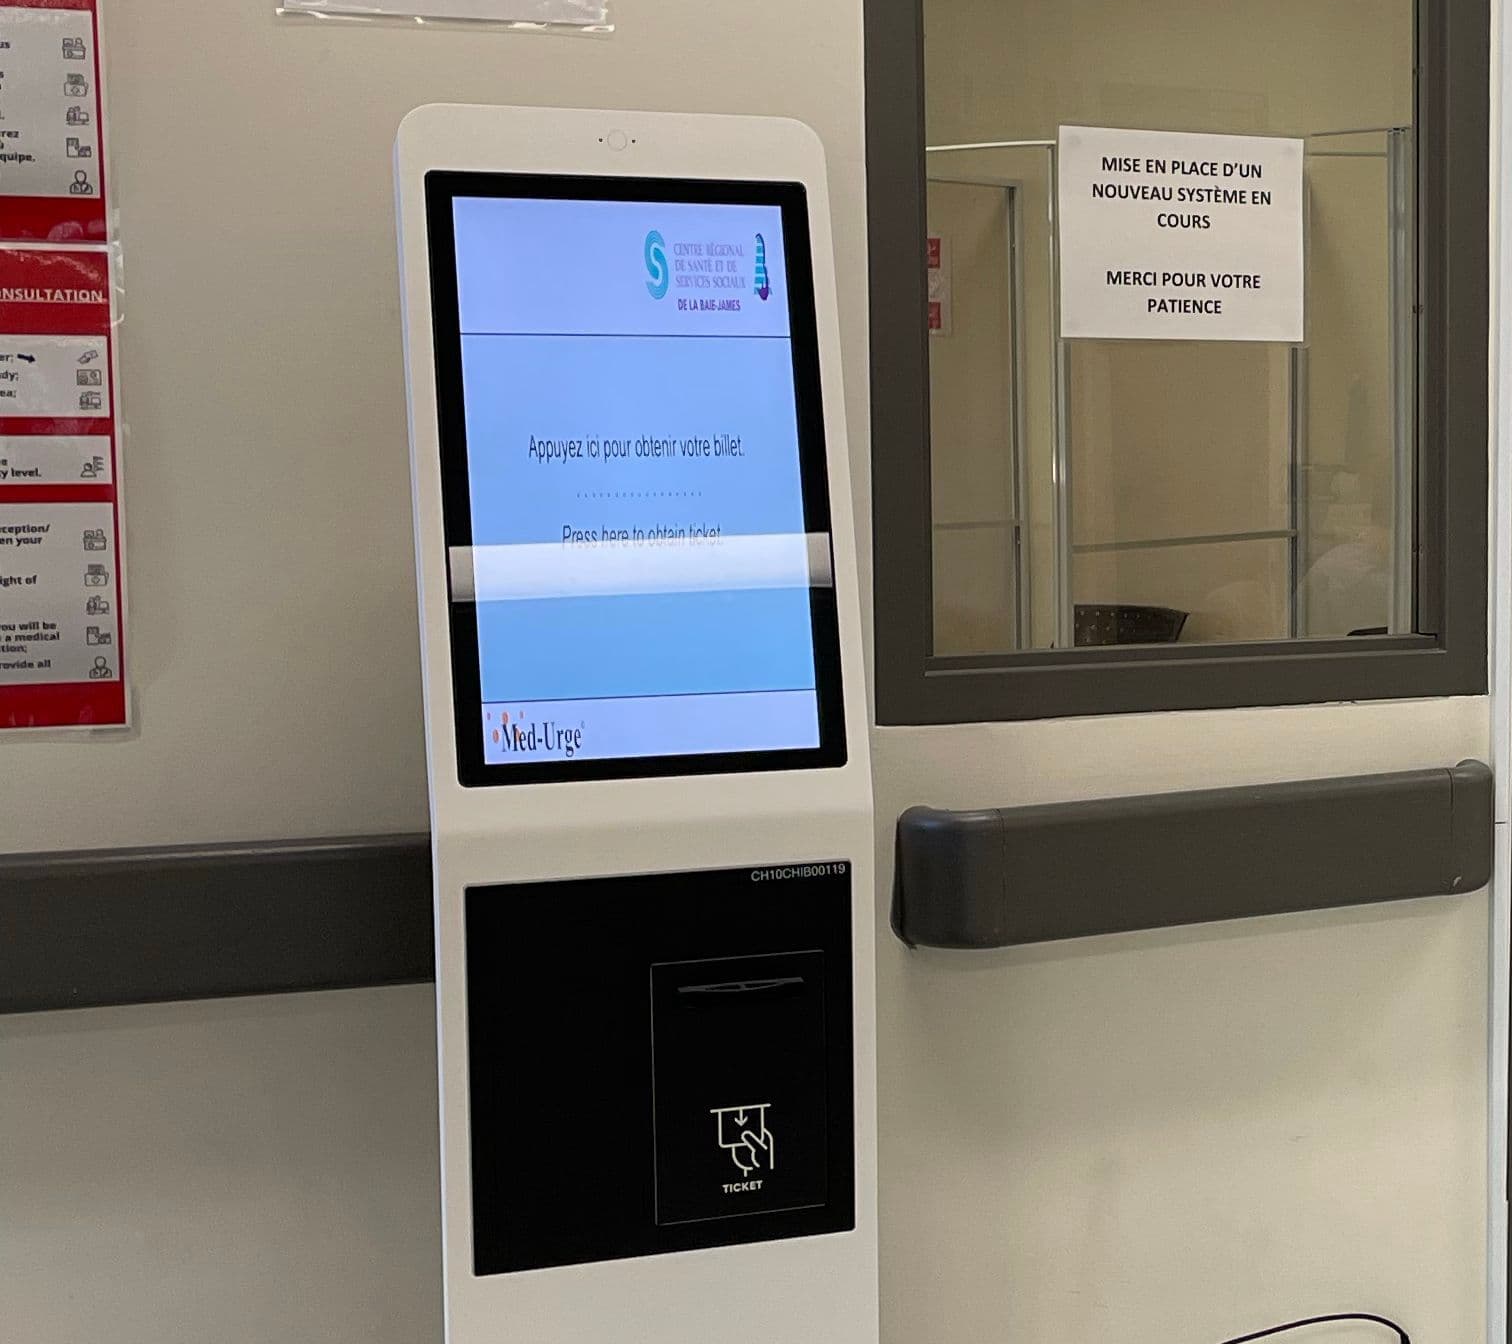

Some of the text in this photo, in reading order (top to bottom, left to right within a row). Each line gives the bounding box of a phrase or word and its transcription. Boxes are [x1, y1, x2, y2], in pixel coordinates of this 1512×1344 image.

[1102, 157, 1262, 178] MISE EN PLACE D'UN
[1092, 183, 1271, 205] NOUVEAU SYSTÈME EN
[1157, 213, 1211, 229] COURS
[673, 243, 702, 256] CENTRE
[1106, 270, 1261, 289] MERCI POUR VOTRE
[0, 288, 103, 303] NSULTATION
[678, 298, 687, 311] DE
[689, 299, 698, 311] LA
[1147, 298, 1222, 314] PATIENCE
[528, 433, 745, 464] Appuyez ici pour obtenir votre billet.
[15, 536, 43, 547] your
[562, 524, 598, 547] Press
[601, 523, 629, 546] here
[633, 523, 644, 546] to
[648, 522, 686, 544] obtain
[15, 632, 60, 642] medical
[502, 721, 582, 758] Med-Urge
[750, 863, 846, 882] CH10CHIB00119
[722, 1179, 764, 1194] TICKET
